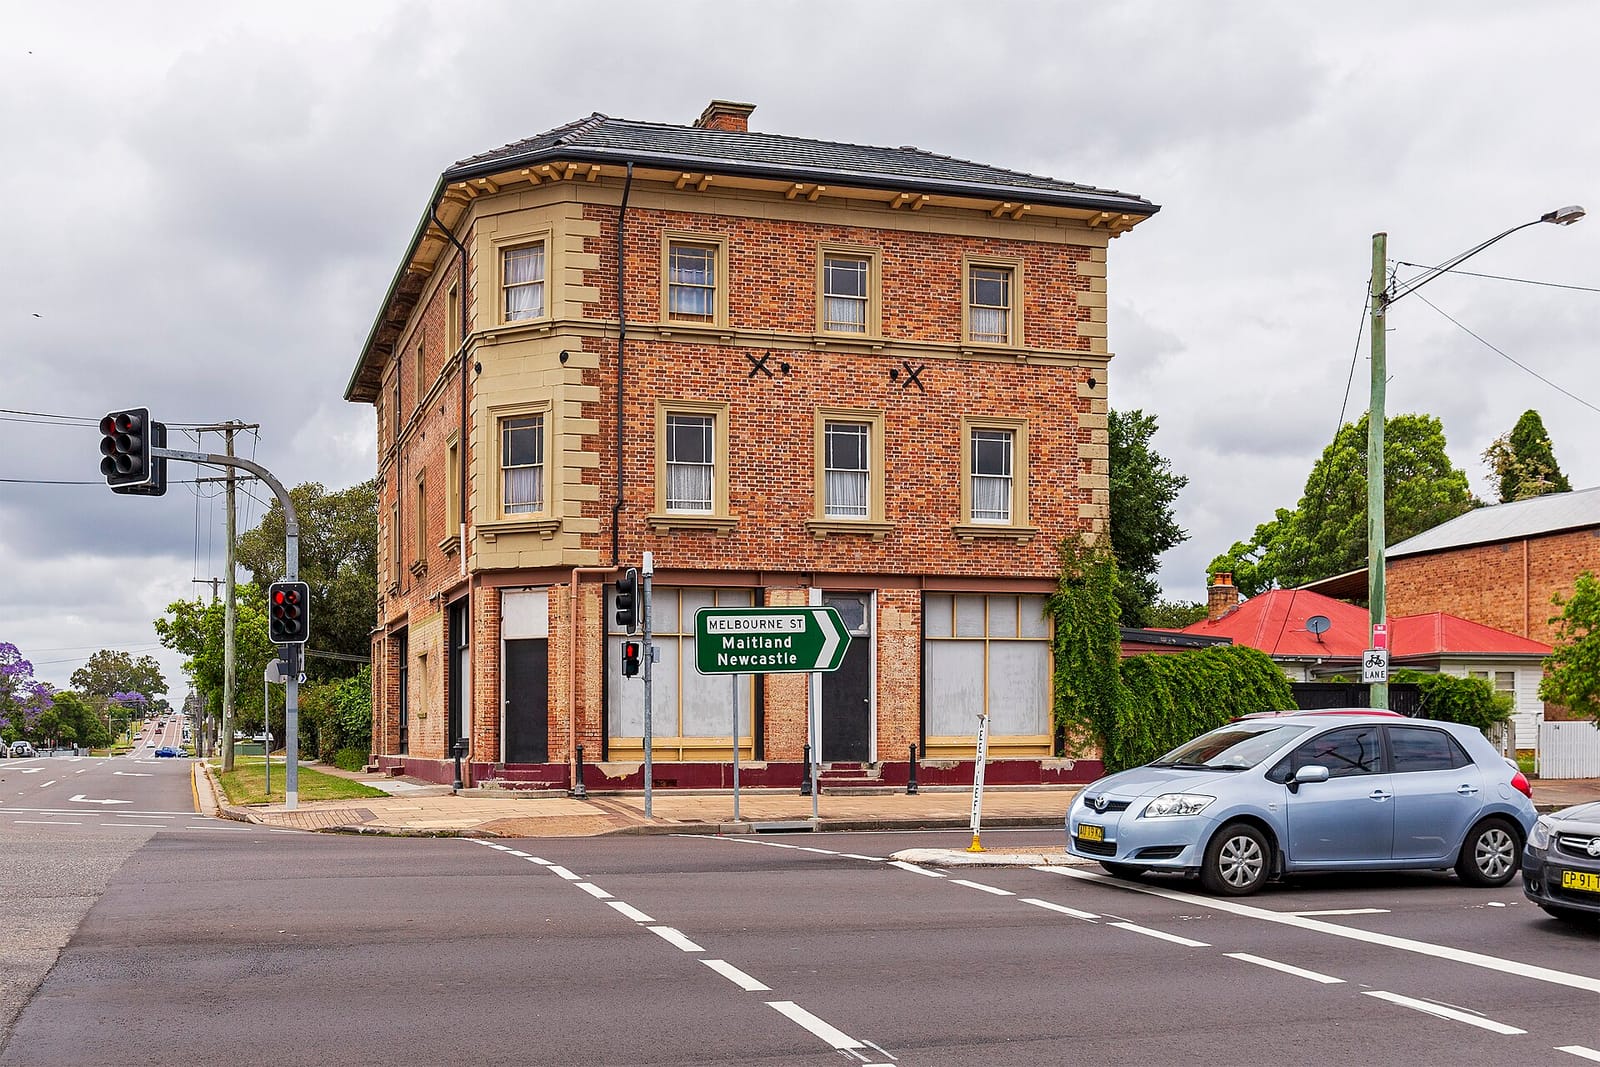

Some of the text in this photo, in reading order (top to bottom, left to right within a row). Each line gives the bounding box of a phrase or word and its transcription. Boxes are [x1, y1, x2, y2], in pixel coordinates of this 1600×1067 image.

[709, 619, 803, 630] MELBOURNE ST
[722, 635, 792, 649] Maitland
[717, 652, 797, 665] Newcastle
[1564, 872, 1576, 885] CP
[1580, 874, 1590, 887] 91
